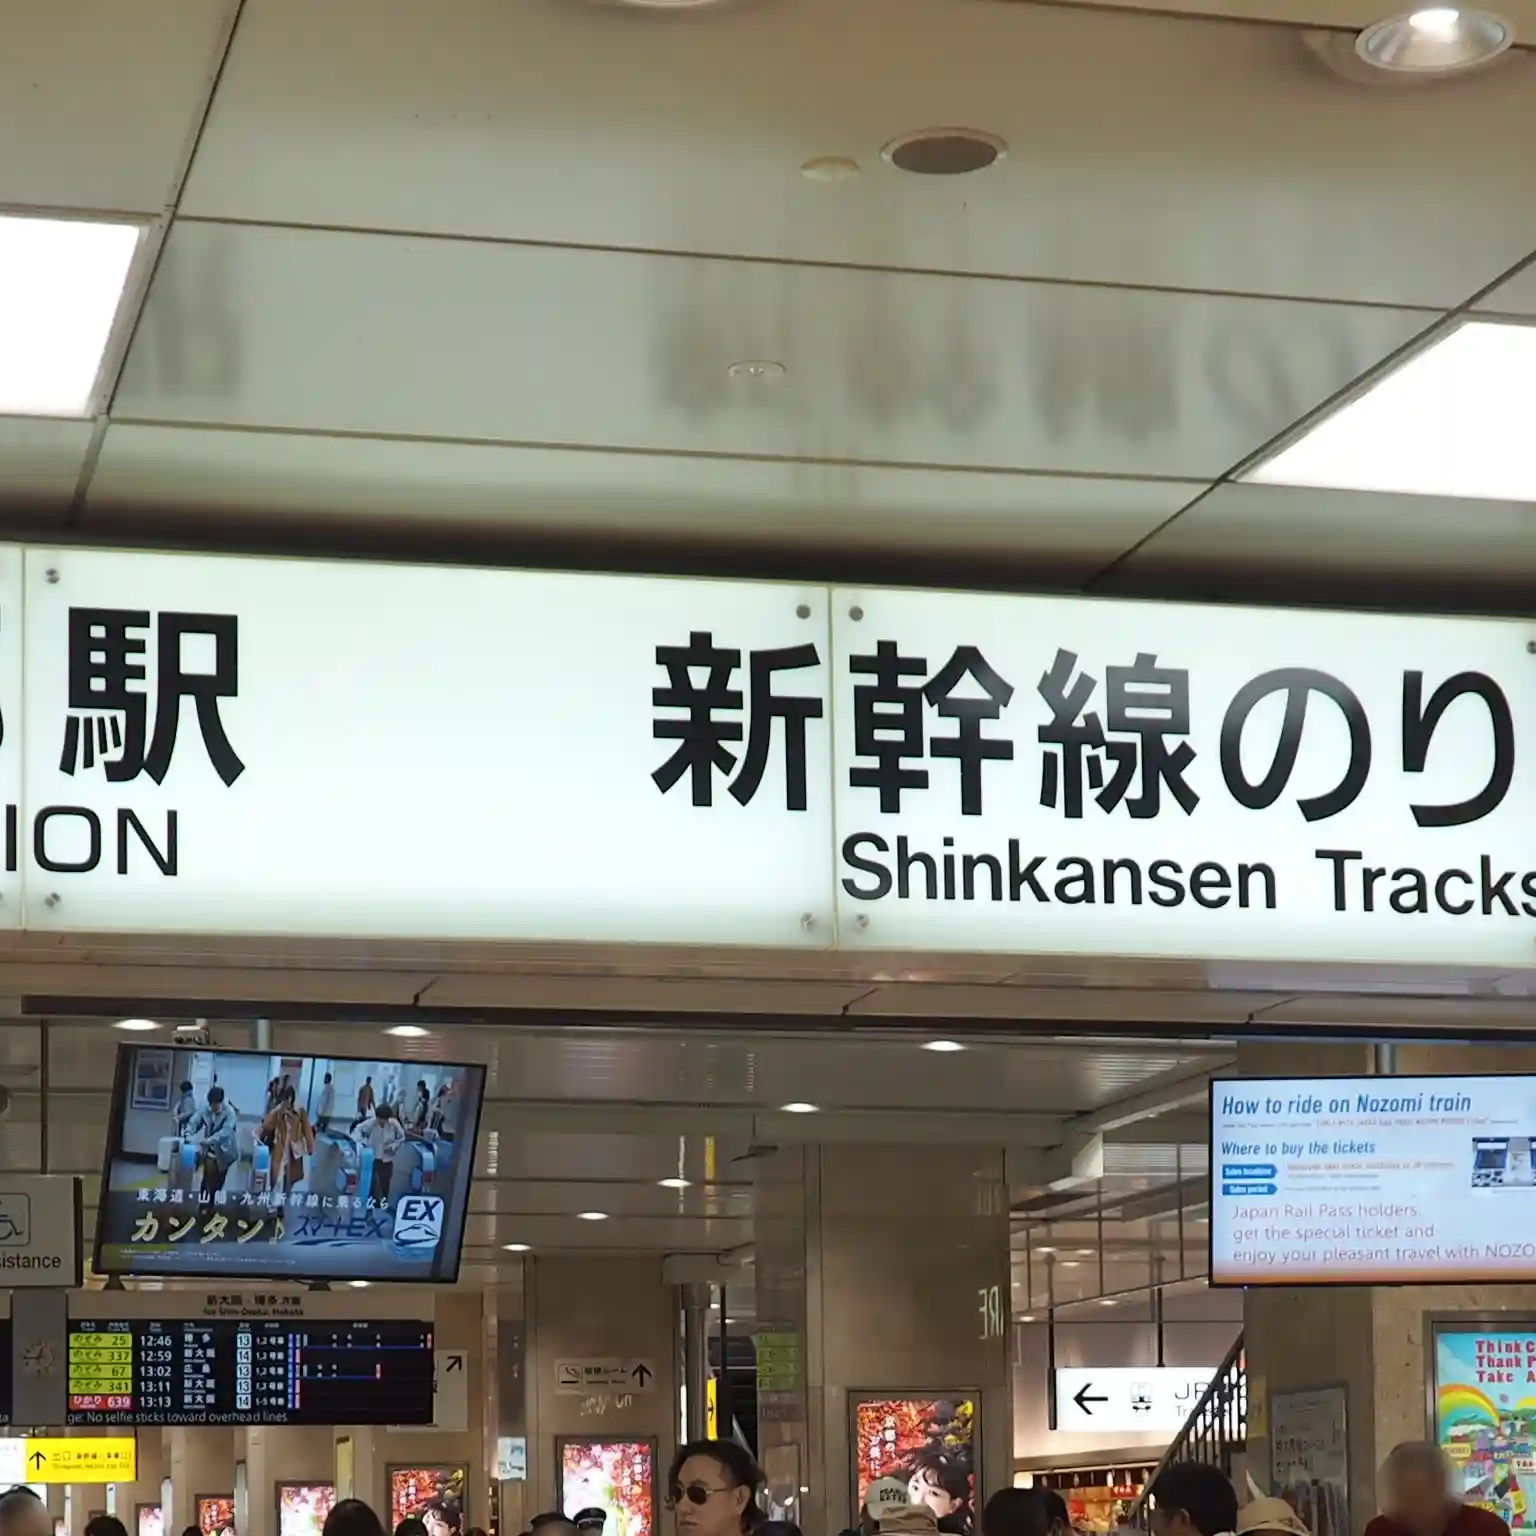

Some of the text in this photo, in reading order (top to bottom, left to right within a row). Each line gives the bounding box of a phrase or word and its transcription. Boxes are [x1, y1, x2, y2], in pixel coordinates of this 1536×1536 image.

[842, 833, 1275, 908] Shinkansen
[1223, 1094, 1471, 1115] How to ride on Nozomi train
[1221, 1141, 1376, 1158] Where to buy the tickets
[402, 1200, 440, 1222] EX
[1233, 1205, 1278, 1221] Japan
[1285, 1204, 1312, 1218] Rail
[1319, 1203, 1352, 1217] Pass
[1233, 1224, 1434, 1244] get the special ticket and
[1233, 1246, 1275, 1264] enjoy
[1282, 1248, 1316, 1263] your
[1323, 1246, 1389, 1263] pleasant
[1396, 1246, 1440, 1260] travel
[1446, 1244, 1479, 1259] with
[112, 1335, 126, 1345] 25
[140, 1335, 172, 1347] 12:46
[238, 1336, 250, 1347] 13
[1475, 1340, 1522, 1354] Think
[109, 1351, 130, 1361] 337
[140, 1350, 172, 1362] 12:59
[238, 1351, 250, 1362] 14
[1476, 1355, 1522, 1368] Thank
[112, 1366, 126, 1377] 67
[140, 1365, 172, 1377] 13:02
[238, 1366, 250, 1377] 13
[1476, 1370, 1515, 1383] Take
[108, 1381, 129, 1392] 341
[140, 1381, 171, 1393] 13:11
[238, 1381, 250, 1392] 13
[107, 1396, 131, 1408] 639
[140, 1396, 172, 1408] 13:13
[238, 1396, 250, 1407] 14
[87, 1411, 104, 1423] No
[106, 1411, 134, 1423] selfie
[135, 1411, 165, 1423] sticks
[168, 1411, 206, 1423] toward
[209, 1411, 260, 1423] overhead
